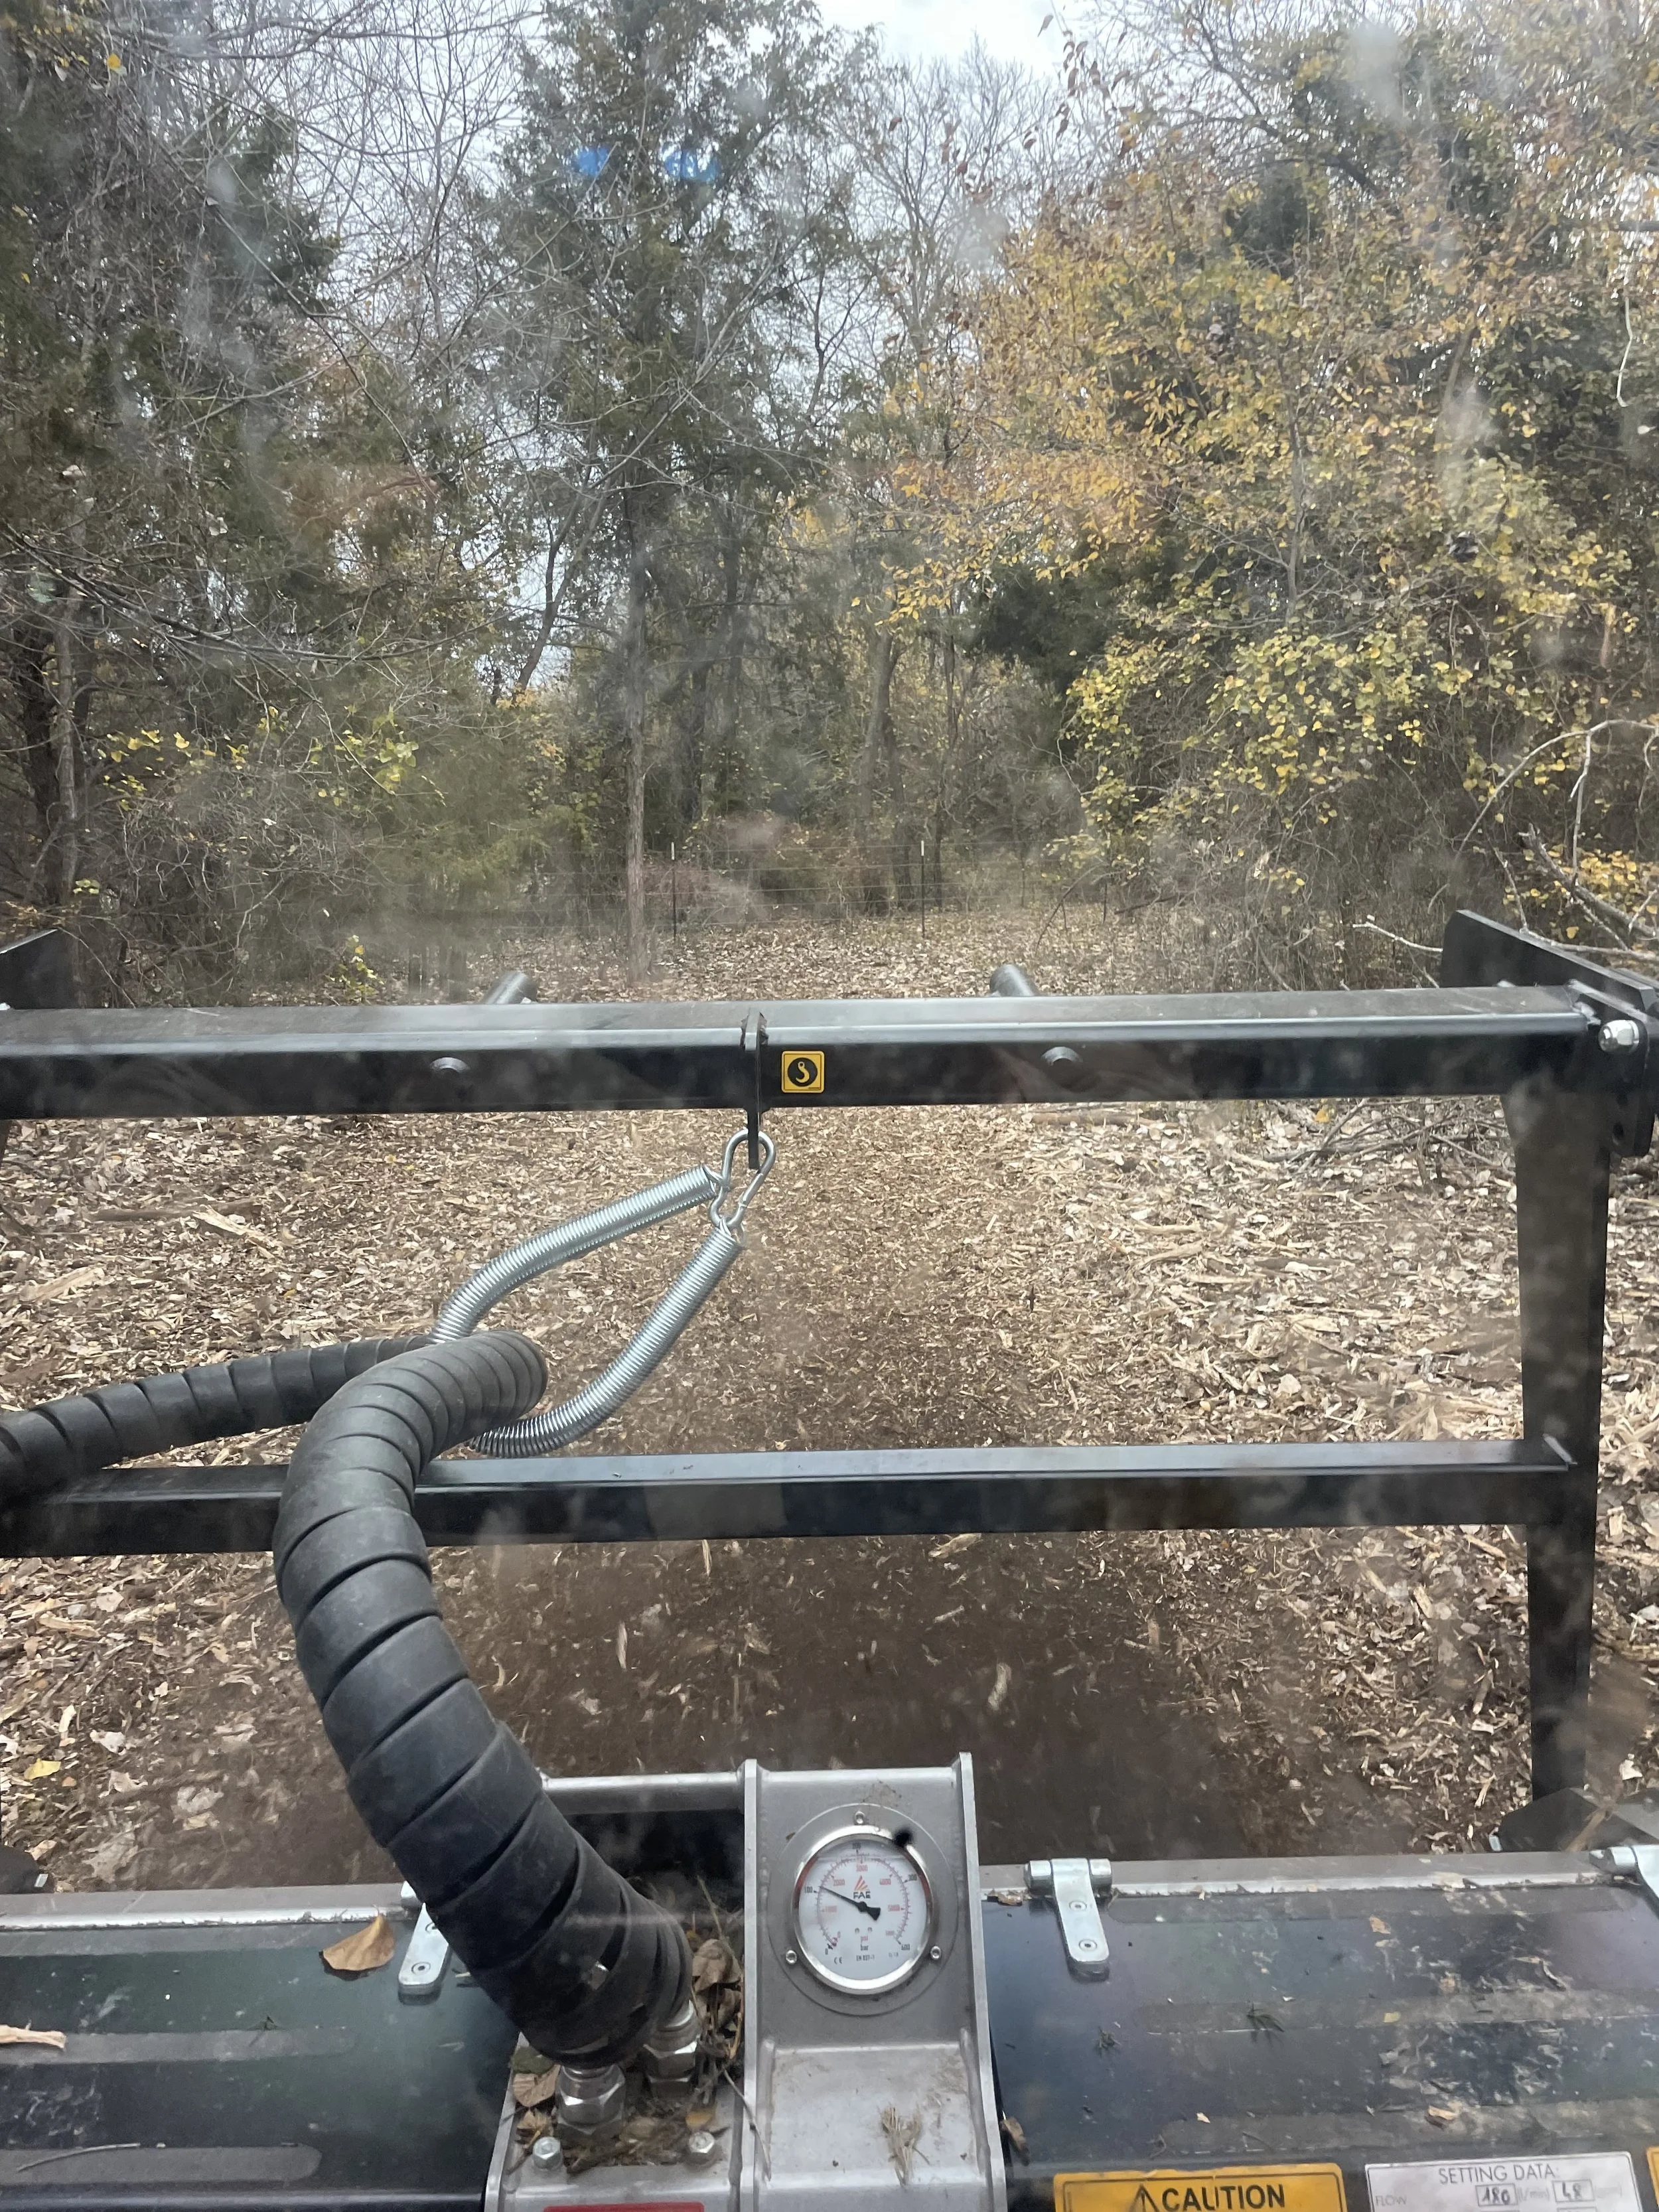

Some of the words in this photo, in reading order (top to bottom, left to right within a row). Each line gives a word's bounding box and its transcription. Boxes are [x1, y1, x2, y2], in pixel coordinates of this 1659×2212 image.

[1438, 2164, 1508, 2185] SETTING
[1161, 2183, 1285, 2211] CAUTION
[1375, 2195, 1407, 2207] FLOW
